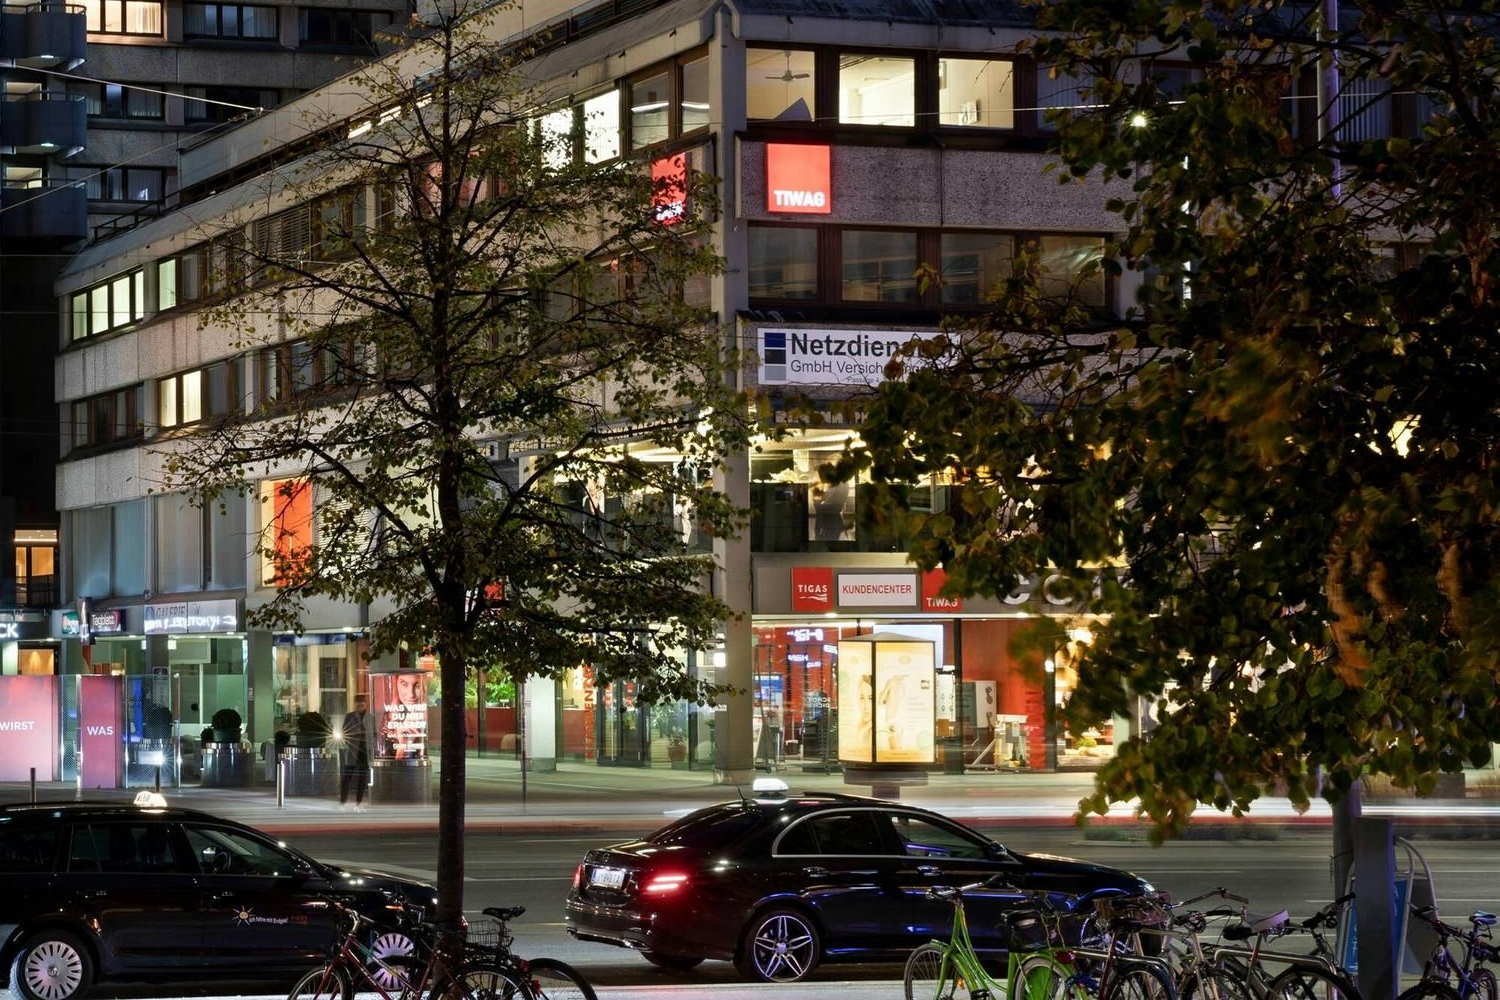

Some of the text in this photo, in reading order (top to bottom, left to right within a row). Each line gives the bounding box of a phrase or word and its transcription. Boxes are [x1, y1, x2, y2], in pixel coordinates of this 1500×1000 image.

[773, 190, 826, 208] TIWAG
[791, 332, 922, 358] Netzdien
[790, 359, 832, 374] GmbH
[798, 584, 828, 593] TIGAS
[842, 584, 912, 594] KUNDENCENTER
[926, 597, 958, 608] TIWAG
[86, 725, 114, 736] WAS
